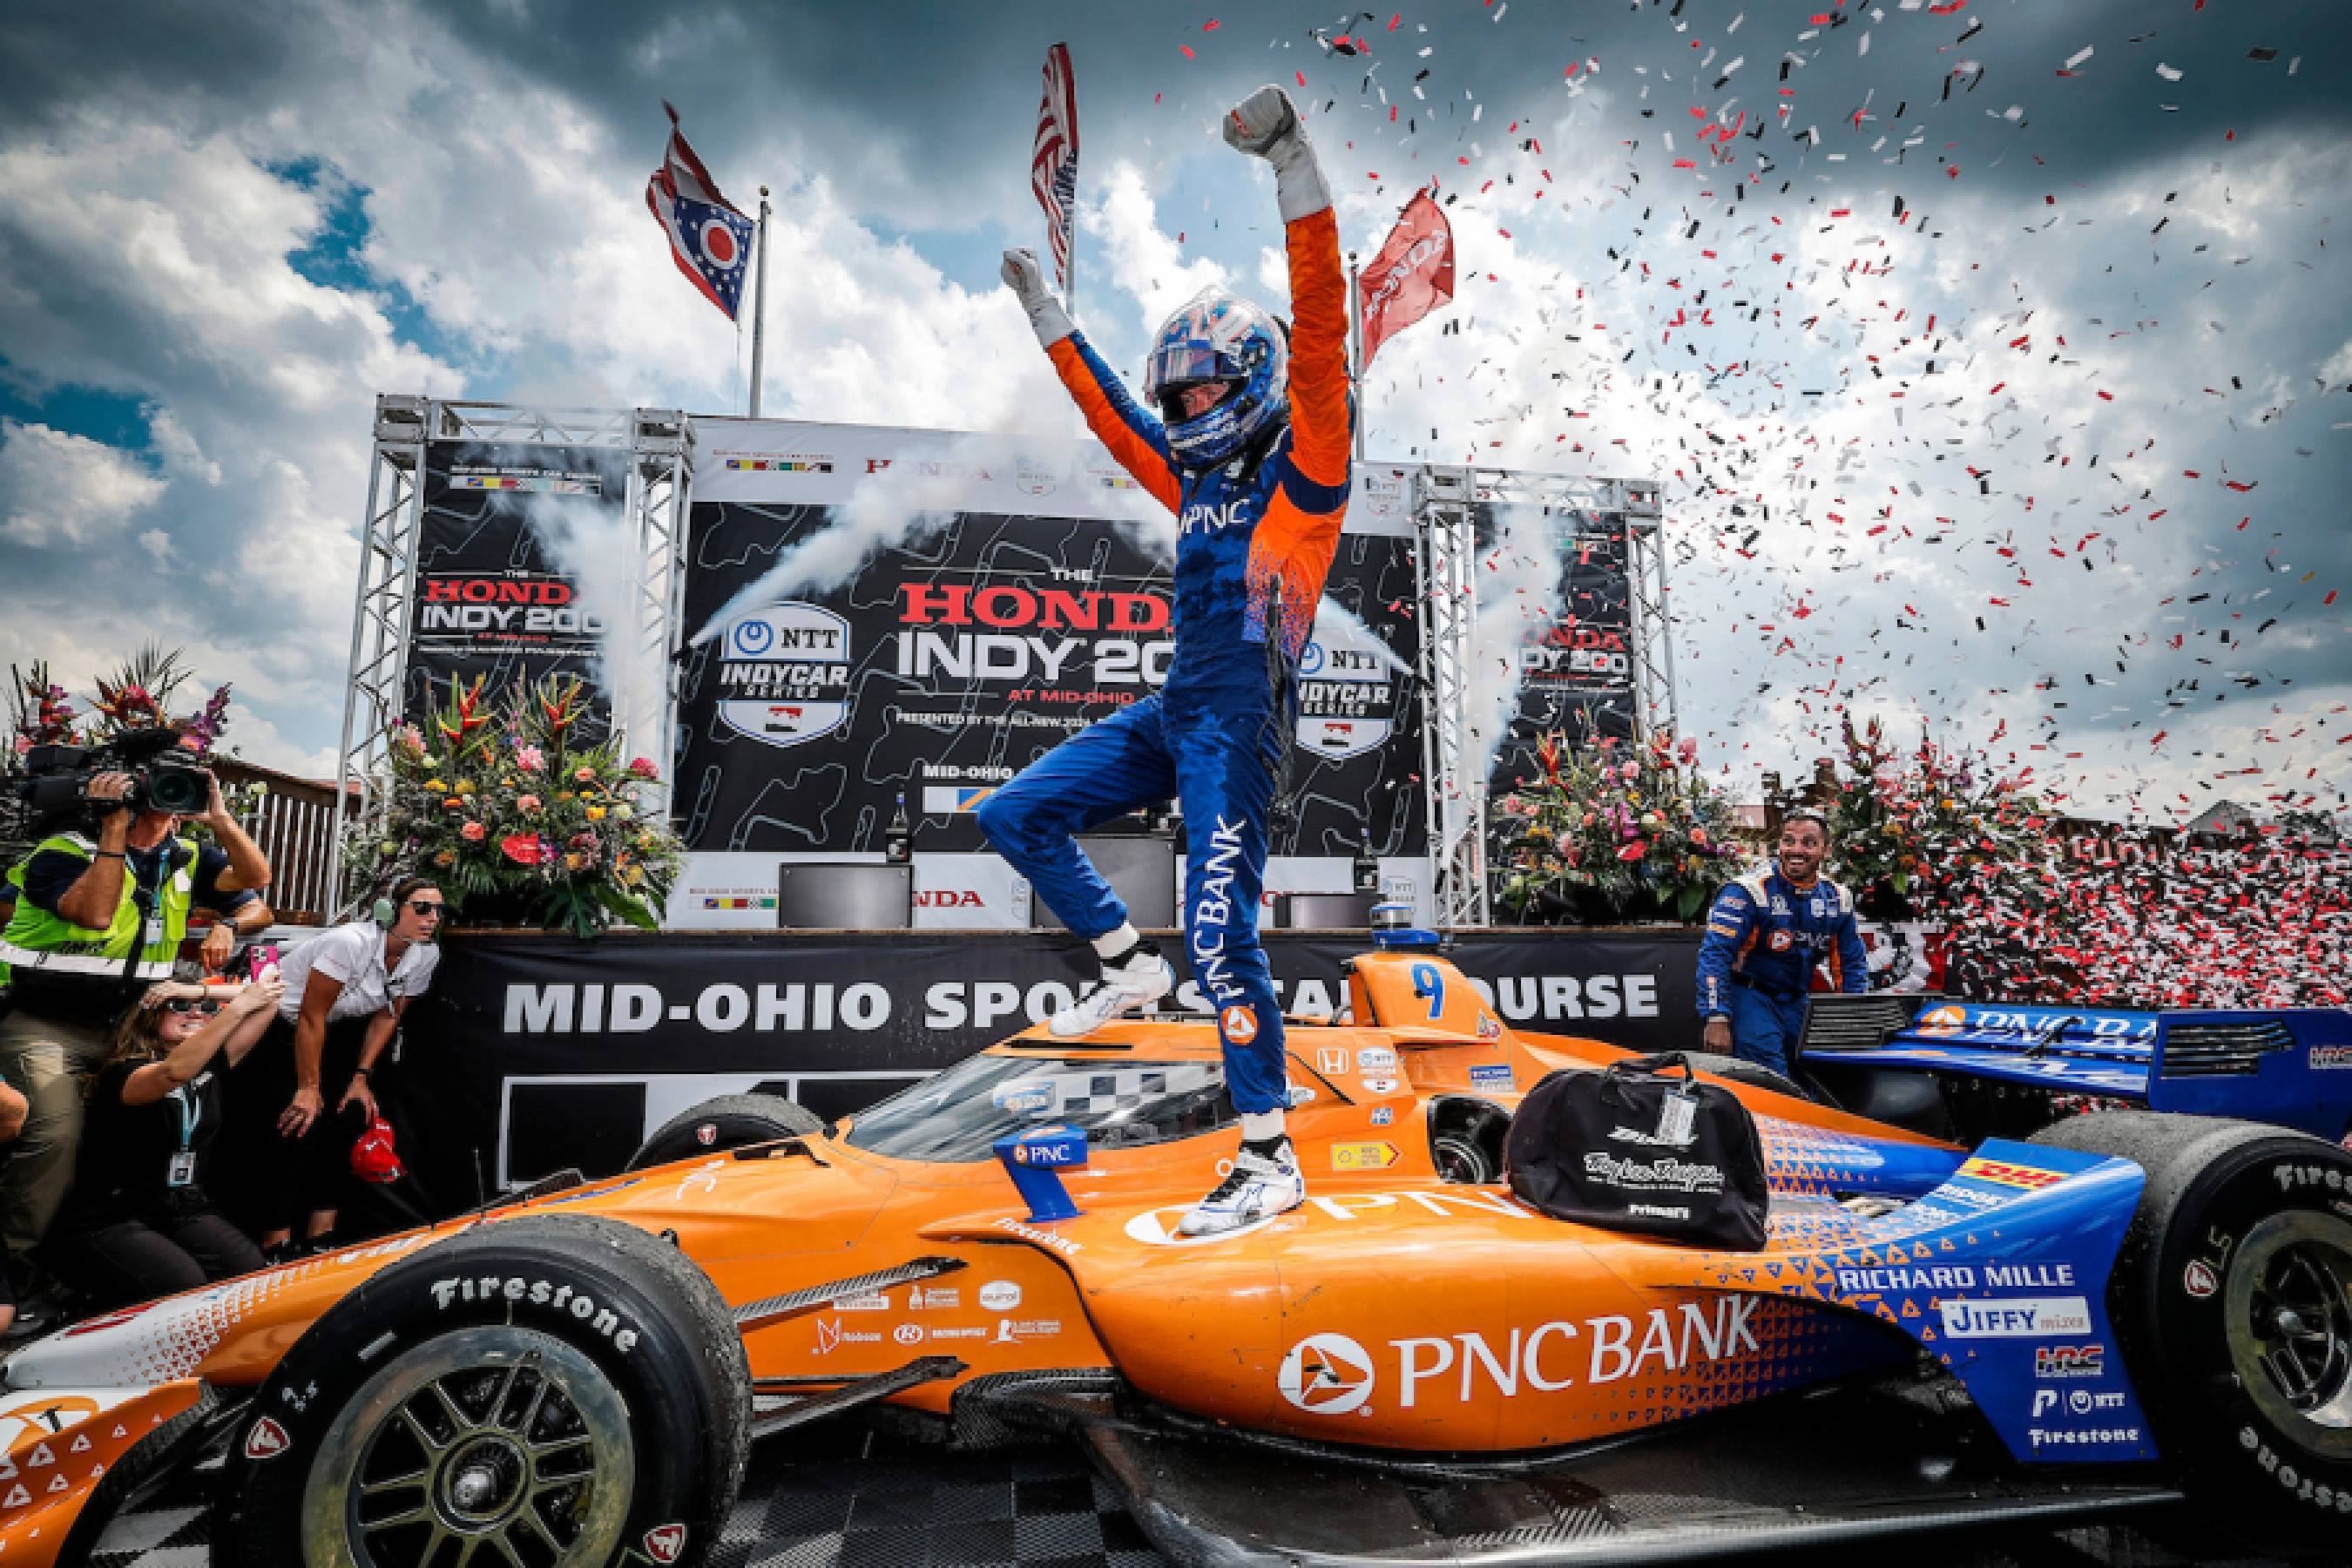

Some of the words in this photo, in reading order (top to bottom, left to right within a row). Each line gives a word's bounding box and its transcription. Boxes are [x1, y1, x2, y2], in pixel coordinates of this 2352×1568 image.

[1365, 230, 1448, 322] HONDA
[1186, 498, 1250, 534] PNC
[1050, 568, 1093, 582] THE
[424, 579, 573, 605] HOND
[422, 605, 520, 630] INDY
[899, 582, 1173, 633] HOND
[781, 629, 839, 649] NTT
[1521, 627, 1626, 652] ONDA
[897, 632, 1089, 681] INDY
[1093, 640, 1173, 686] 20
[1520, 648, 1568, 672] DY
[720, 663, 848, 686] INDYCAR
[745, 685, 820, 699] SERIES
[1008, 689, 1035, 702] AT
[1040, 690, 1135, 705] MID-OHIO
[1298, 682, 1391, 703] NDYCAR
[923, 764, 1014, 781] MID-OHIO
[1196, 814, 1247, 926] BANK
[912, 890, 985, 908] NDA
[1410, 962, 1445, 1020] 9
[504, 982, 892, 1033] MID-OHIO
[925, 981, 1216, 1030] SPOS
[1470, 976, 1661, 1022] URSE
[1031, 1144, 1071, 1162] PNC
[1838, 1266, 1977, 1291] RICHARD
[1984, 1263, 2075, 1288] MILLE
[431, 1275, 639, 1353] Firestone
[1951, 1304, 2037, 1333] JIFFY
[1388, 1321, 1578, 1409] PNC
[1585, 1293, 1761, 1384] BANK
[2036, 1346, 2104, 1371] HRC
[2028, 1428, 2140, 1448] Firestone
[2240, 1425, 2352, 1514] estone
